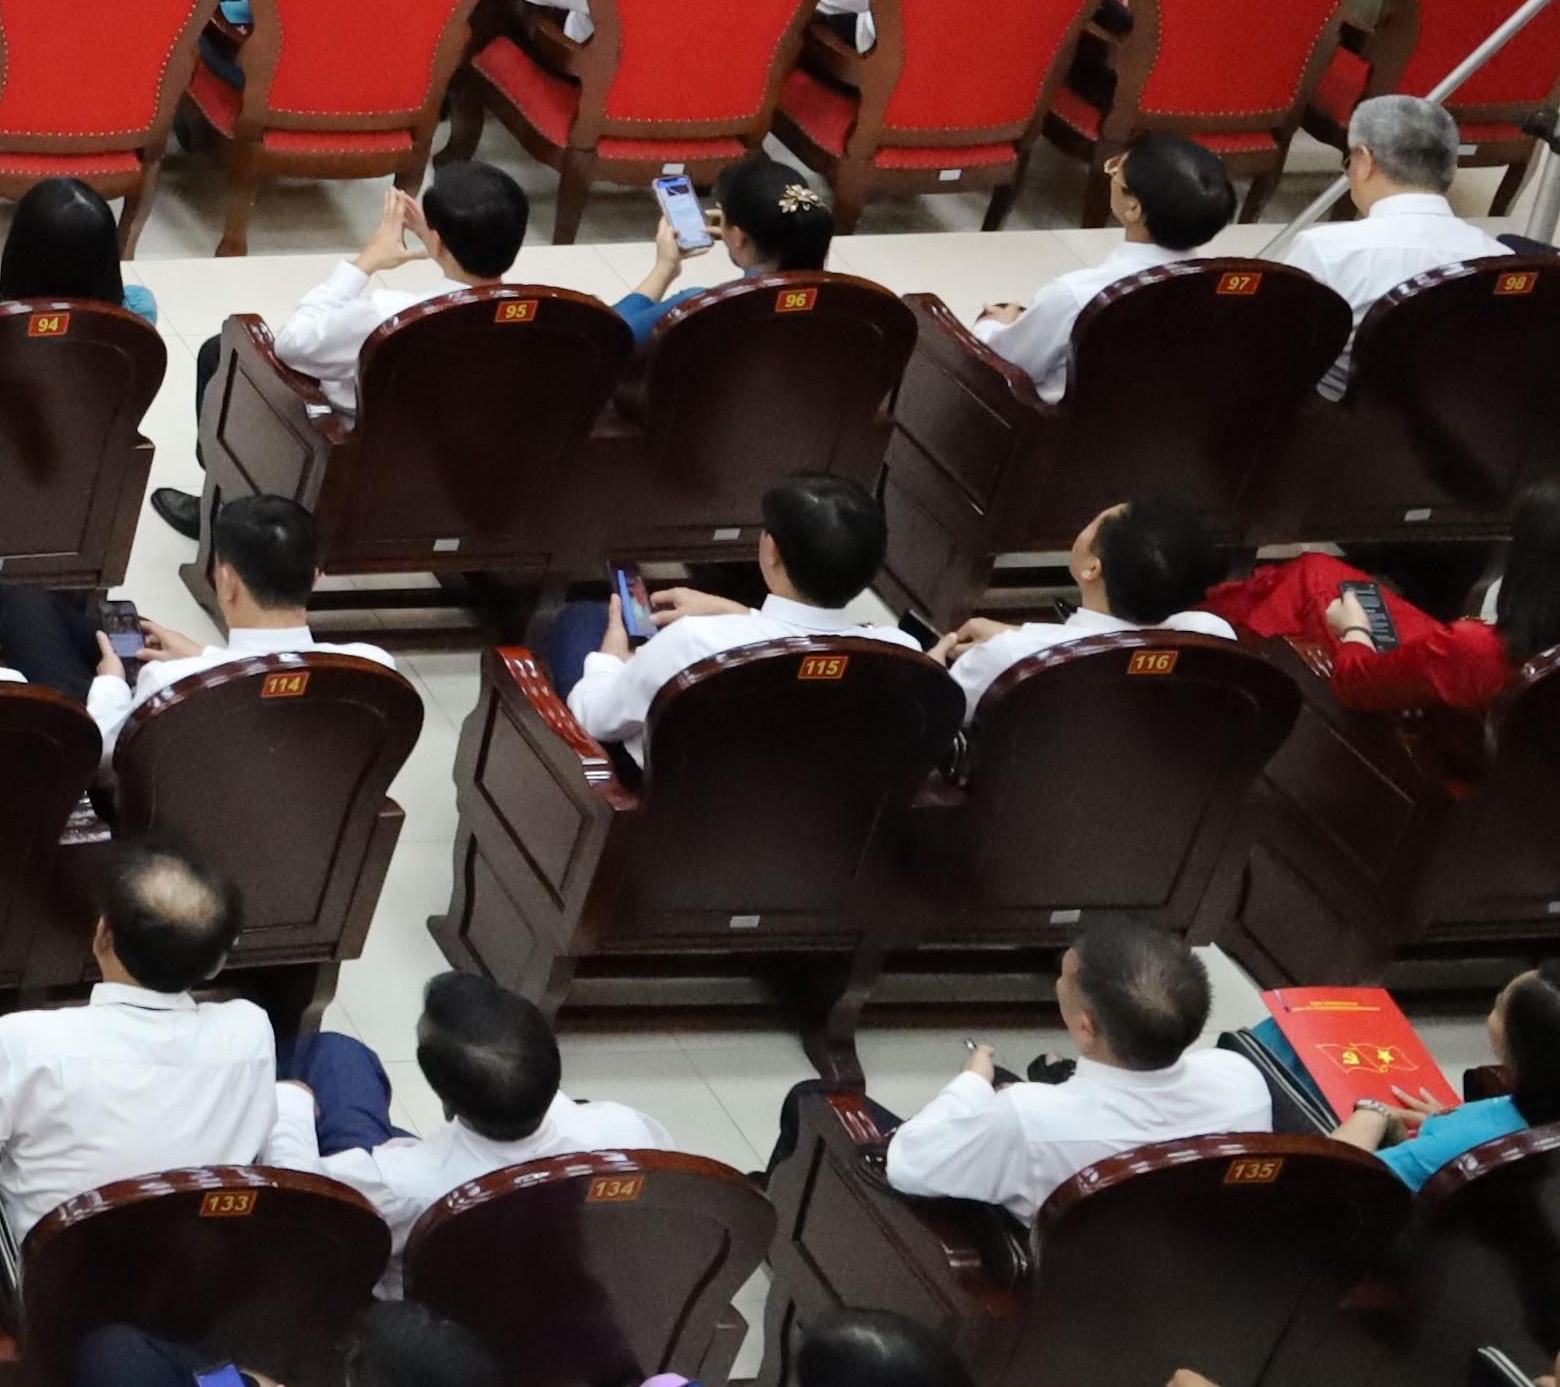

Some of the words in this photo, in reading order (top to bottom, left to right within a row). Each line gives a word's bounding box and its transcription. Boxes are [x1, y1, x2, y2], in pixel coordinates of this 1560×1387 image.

[784, 292, 807, 308] 96
[38, 316, 59, 332] 94
[806, 660, 839, 675] 115
[1235, 1162, 1276, 1179] 135
[209, 1195, 249, 1212] 133
